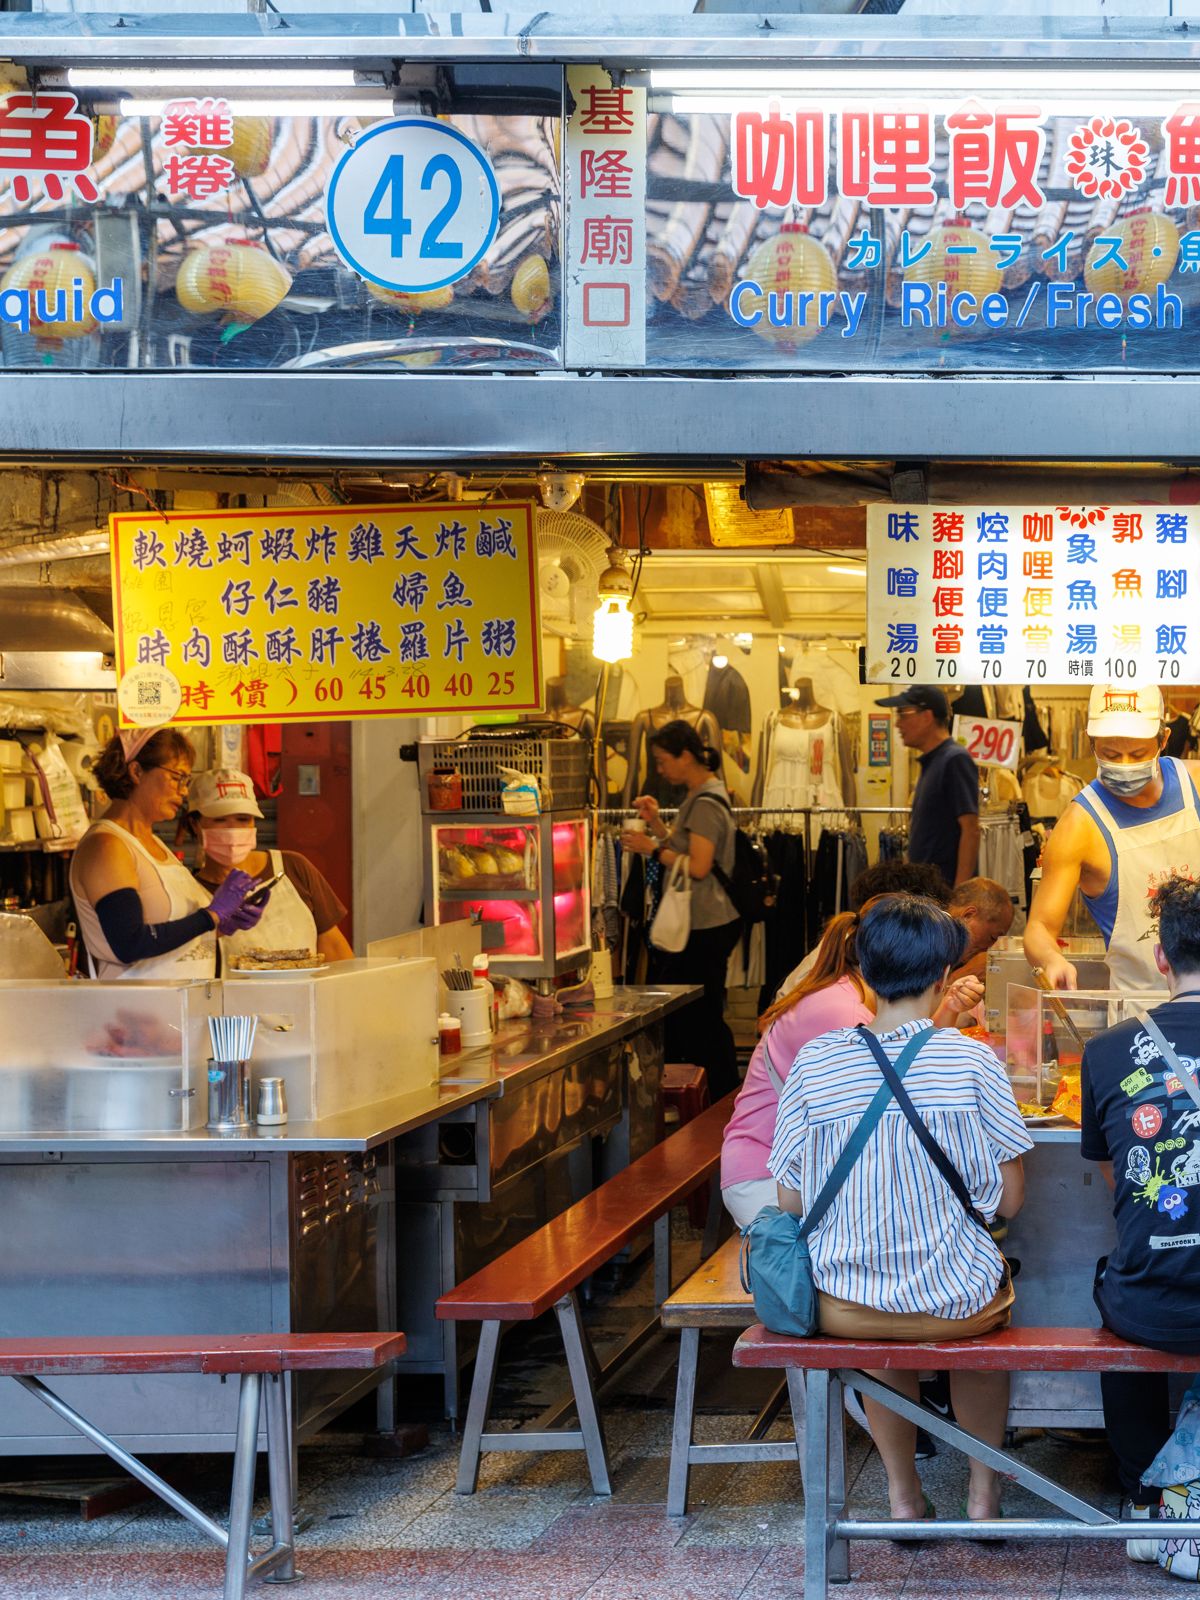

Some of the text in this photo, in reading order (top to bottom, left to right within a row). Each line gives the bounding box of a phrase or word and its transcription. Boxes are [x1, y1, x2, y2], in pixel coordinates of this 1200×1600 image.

[0, 95, 98, 201] 魚
[164, 100, 234, 200] 雞捲
[736, 104, 1044, 209] 咖哩飯
[1089, 140, 1123, 177] 珠
[363, 153, 464, 260] 42
[579, 85, 634, 327] 基隆廟口
[0, 277, 123, 334] quid
[731, 281, 866, 337] Curry
[902, 281, 1182, 329] Rice/Fresh
[887, 511, 919, 653] 味噌湯
[932, 511, 964, 654] 豬腳便當
[1023, 512, 1053, 653] 咖哩便當
[1066, 533, 1098, 654] 象魚湯
[1112, 513, 1142, 653] 郭魚湯
[1156, 513, 1188, 655] 豬腳飯
[315, 677, 343, 701] 60
[359, 675, 386, 699] 45
[402, 673, 430, 698] 40
[444, 672, 472, 697] 40
[488, 671, 515, 695] 25
[891, 657, 916, 677] 20
[936, 659, 957, 678] 70
[981, 659, 1002, 678] 70
[1026, 659, 1047, 678] 70
[1068, 660, 1094, 676] 時價
[1105, 657, 1137, 678] 100
[1158, 659, 1180, 679] 70
[967, 724, 1014, 763] 290
